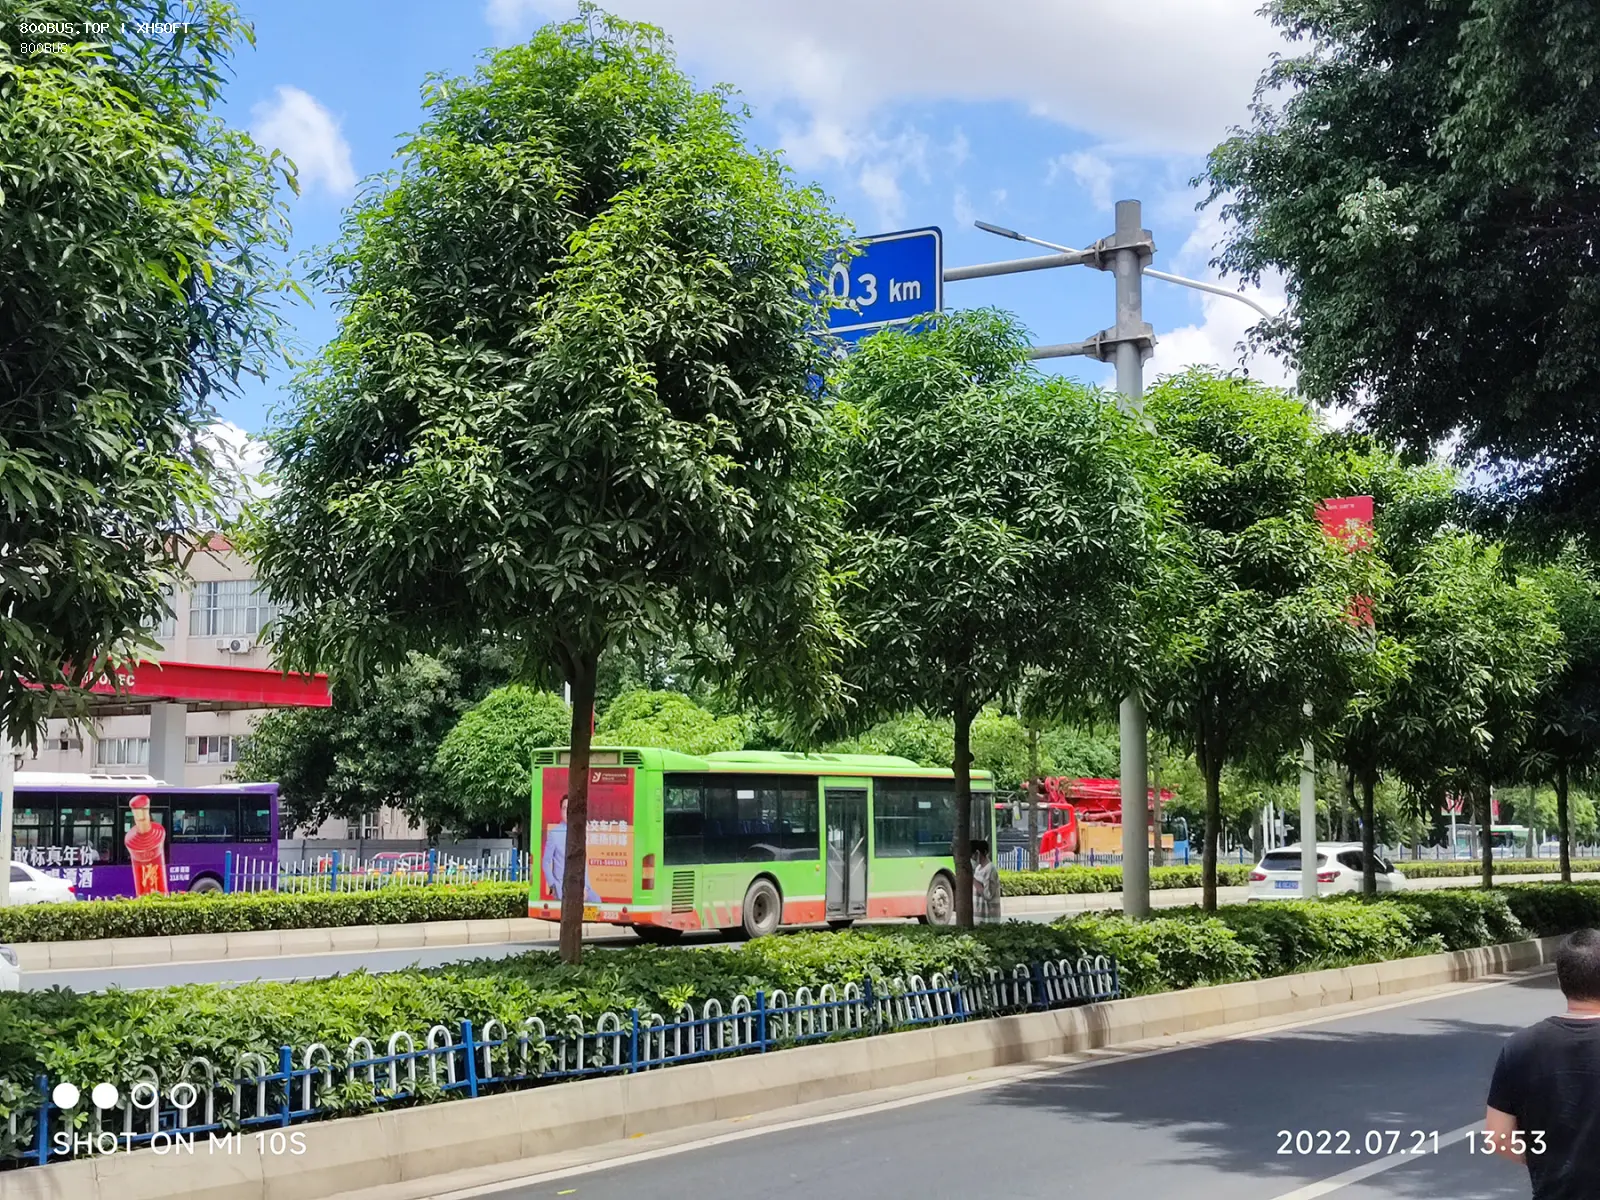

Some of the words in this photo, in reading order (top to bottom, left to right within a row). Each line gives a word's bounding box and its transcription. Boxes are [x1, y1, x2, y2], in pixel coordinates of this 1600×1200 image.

[889, 277, 921, 303] km
[13, 845, 94, 867] 敢标真年份
